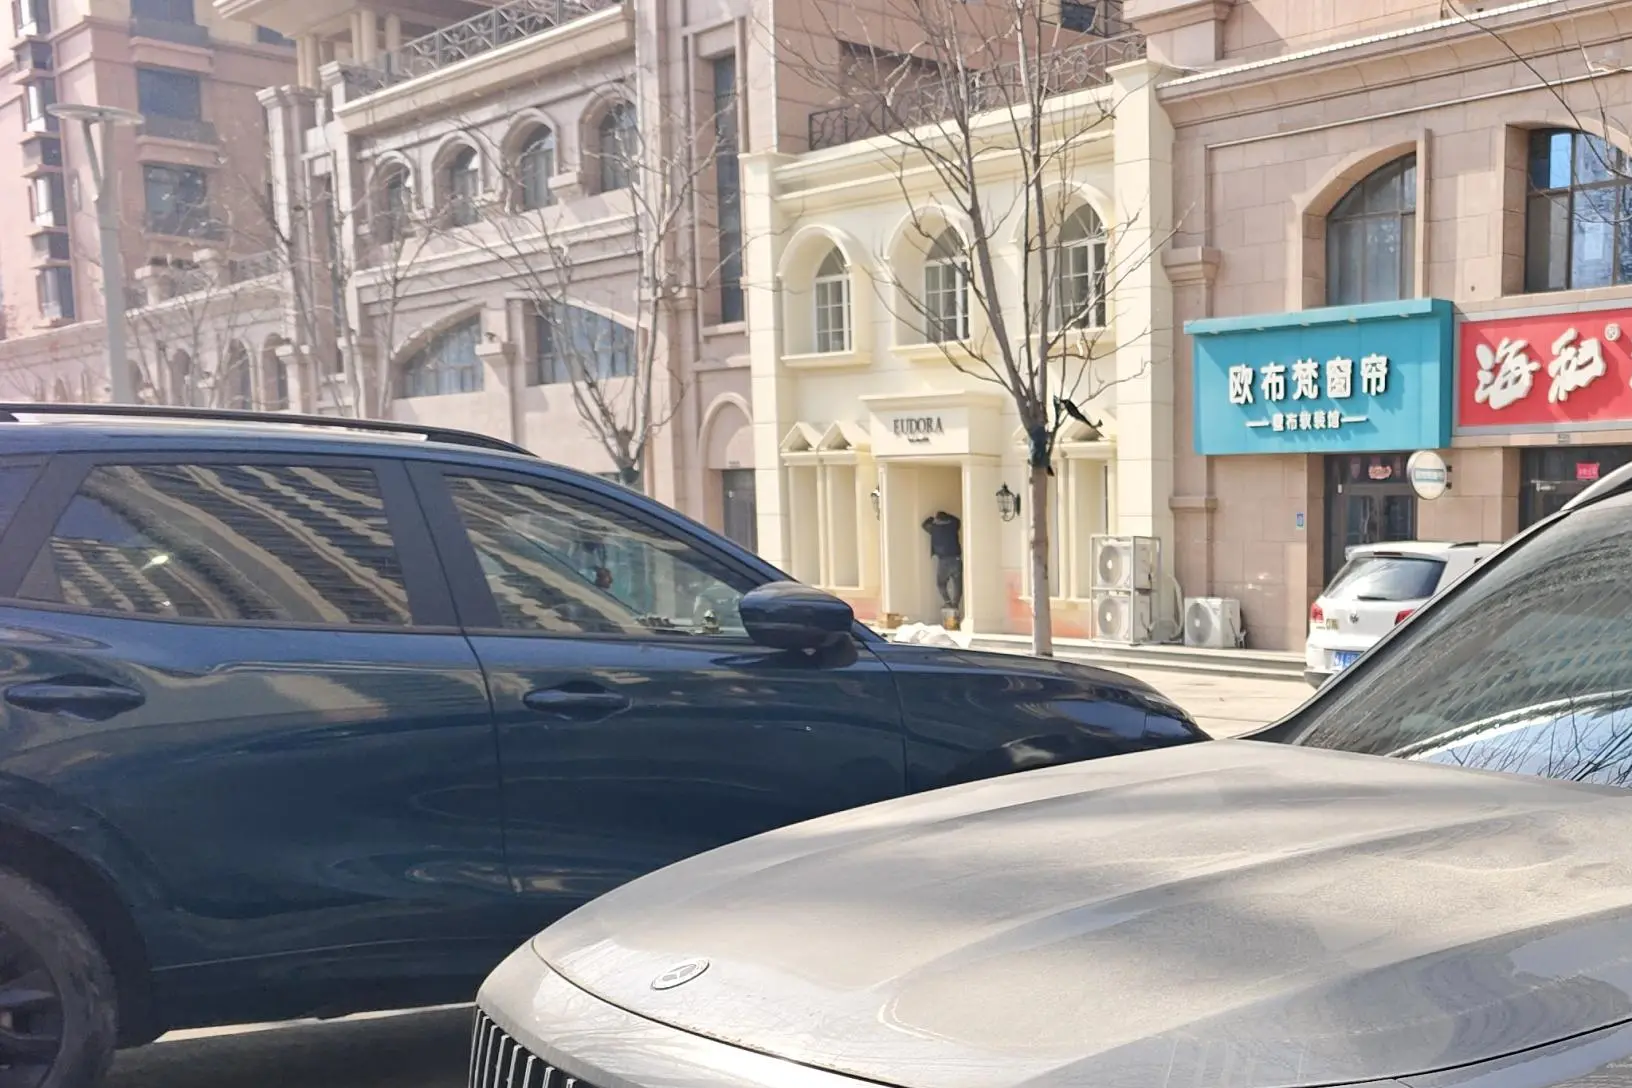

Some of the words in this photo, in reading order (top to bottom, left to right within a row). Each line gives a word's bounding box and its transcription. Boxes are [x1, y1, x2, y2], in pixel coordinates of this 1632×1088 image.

[1228, 352, 1389, 406] 欧布梵窗帘
[893, 416, 945, 436] EUDORA
